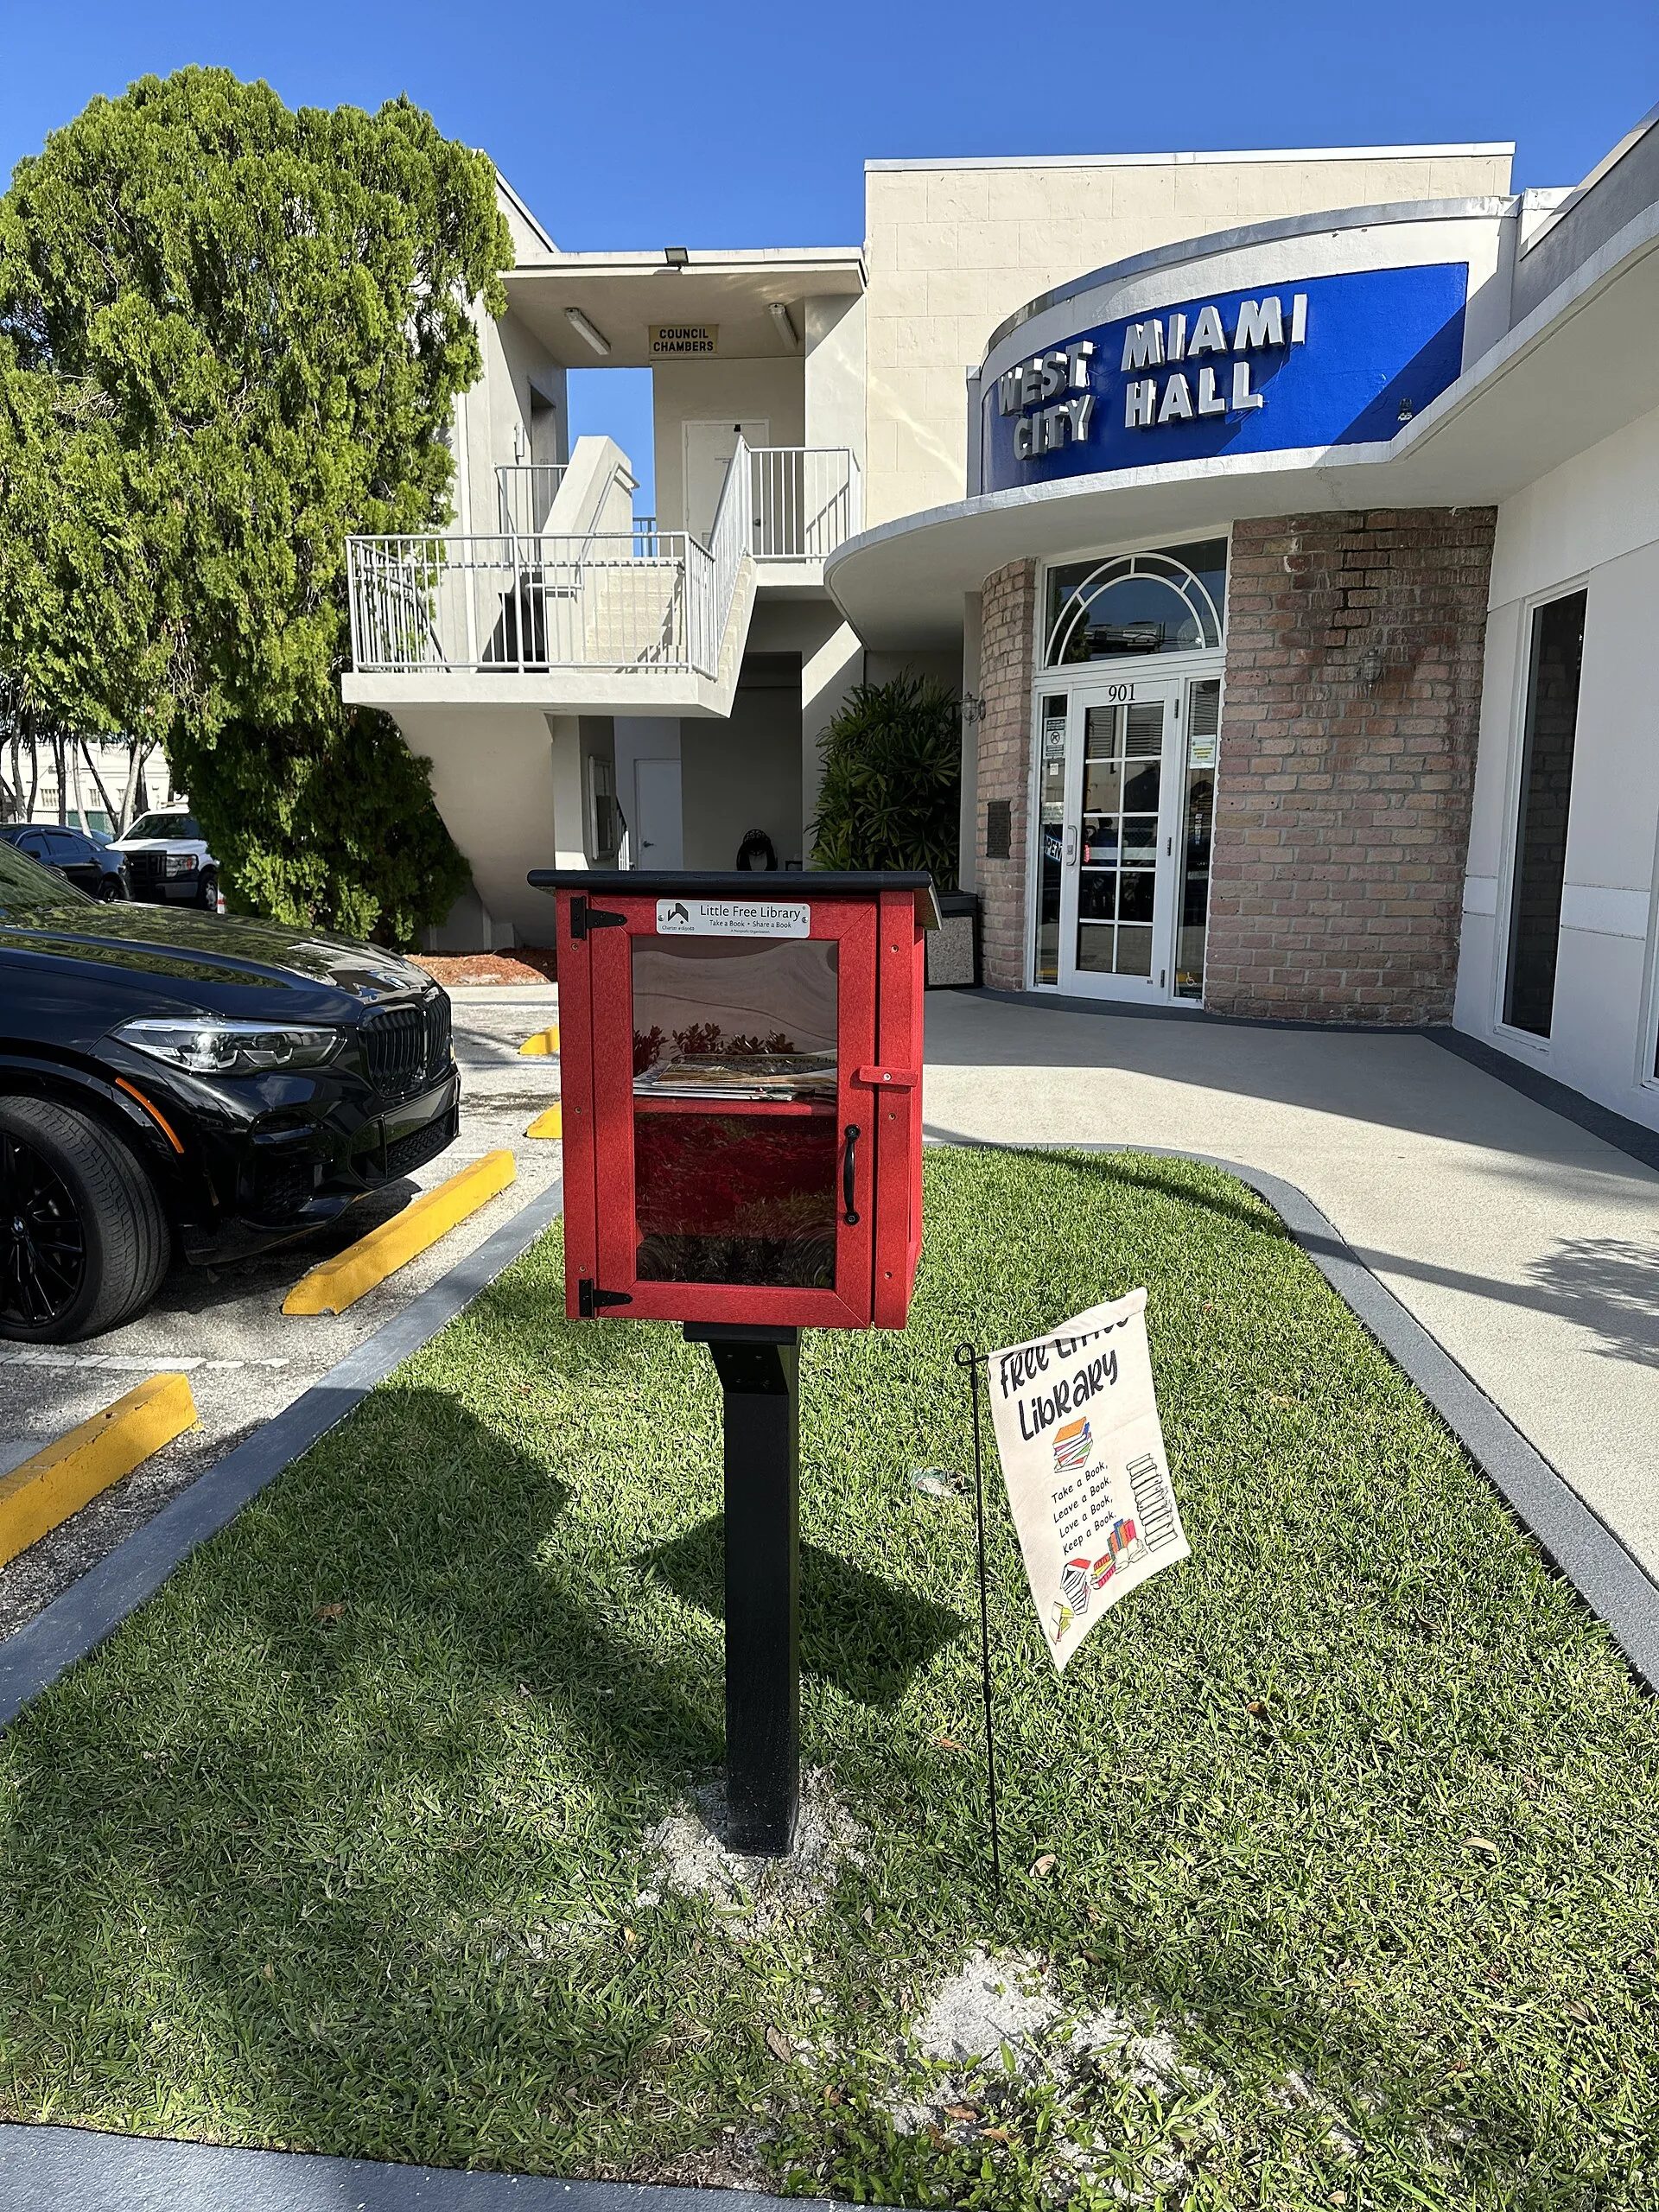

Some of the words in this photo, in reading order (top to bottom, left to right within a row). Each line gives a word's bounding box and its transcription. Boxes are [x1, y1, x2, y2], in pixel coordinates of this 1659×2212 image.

[653, 340, 714, 352] CHAMBERS
[659, 328, 709, 339] COUNCIL
[997, 340, 1095, 417] WEST
[1120, 294, 1308, 372] MIAMI
[1014, 394, 1096, 461] CITY
[1125, 361, 1264, 428] HALL
[1108, 683, 1135, 702] 901
[700, 904, 729, 917] Little
[733, 906, 758, 918] Free
[760, 906, 801, 922] Library
[1052, 1485, 1074, 1503] Take
[1077, 1478, 1083, 1487] a
[1085, 1461, 1109, 1481] Book,
[1053, 1501, 1079, 1523] Leave
[1081, 1494, 1087, 1503] a
[1059, 1519, 1079, 1538] Love
[1090, 1495, 1113, 1515] Book,
[1063, 1535, 1084, 1555] Keep
[1094, 1510, 1116, 1531] Book.
